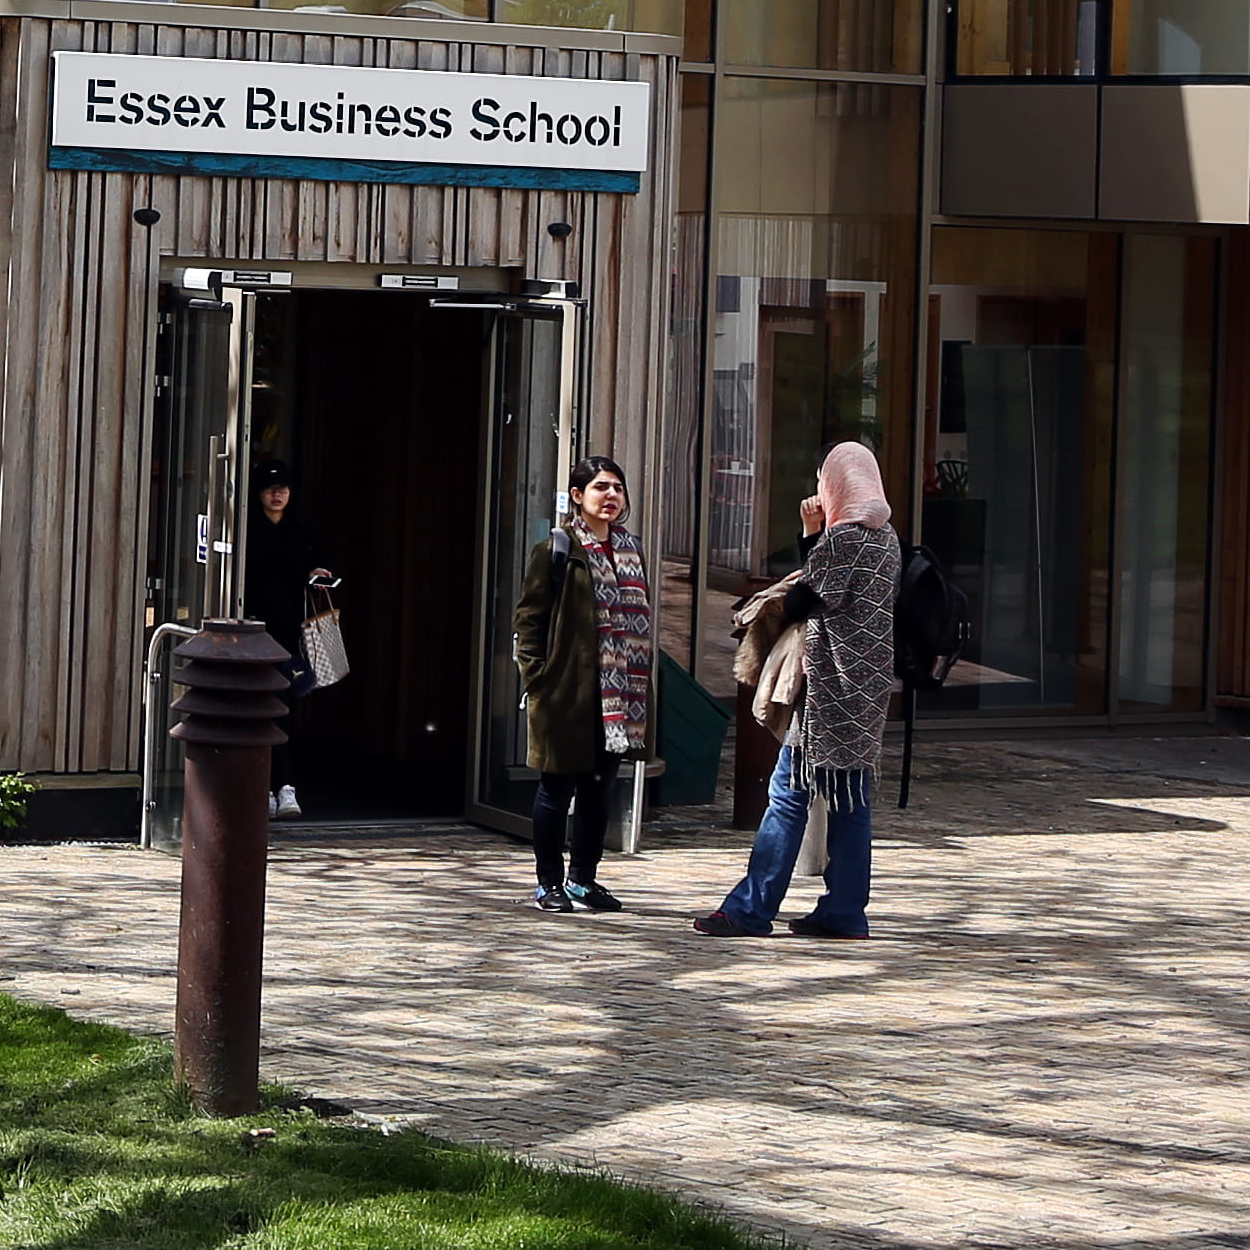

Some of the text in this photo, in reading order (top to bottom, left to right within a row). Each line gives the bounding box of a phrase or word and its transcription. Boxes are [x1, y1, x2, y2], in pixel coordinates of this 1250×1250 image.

[86, 78, 622, 147] Essex Business School
